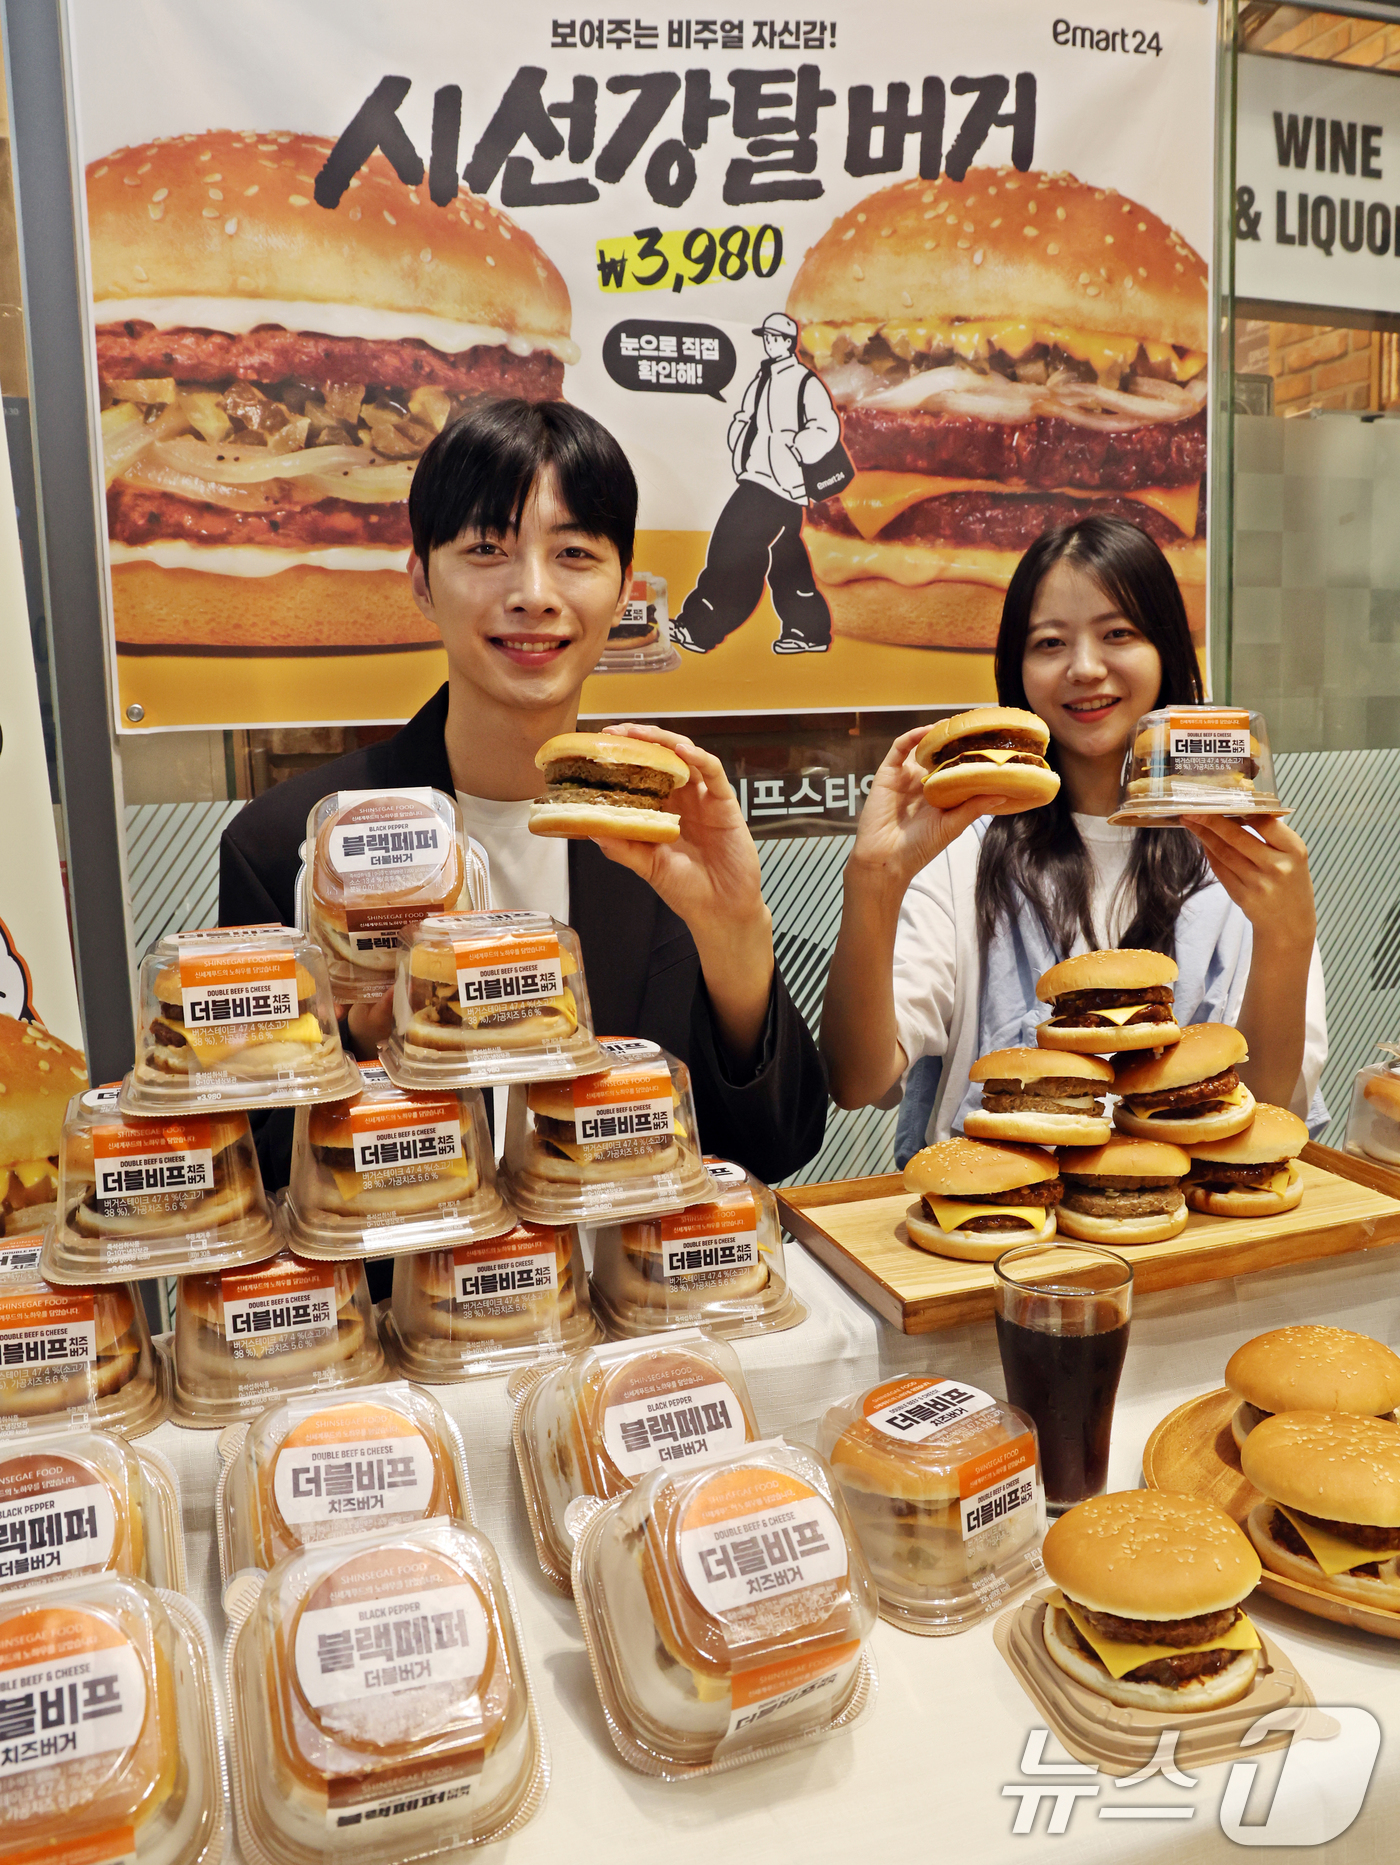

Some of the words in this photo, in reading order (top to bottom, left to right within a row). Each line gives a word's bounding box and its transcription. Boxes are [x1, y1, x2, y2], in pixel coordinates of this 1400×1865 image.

[551, 19, 659, 49] 보여주는
[668, 20, 744, 49] 비주얼
[752, 20, 837, 49] 자신감!
[1052, 19, 1162, 57] emart24
[314, 64, 837, 208] 시선강탈
[844, 72, 1037, 181] 버거
[1273, 111, 1383, 179] WINE
[1236, 185, 1261, 241] &
[1276, 190, 1400, 257] LIQUO
[597, 224, 783, 293] ₩3,980
[620, 332, 678, 357] 눈으로
[682, 337, 719, 360] 직접
[638, 360, 703, 384] 확인해!
[817, 472, 845, 490] emart24
[1175, 739, 1231, 753] 더블비프
[342, 829, 438, 857] 블랙페퍼
[370, 853, 413, 865] 더블버거
[480, 969, 500, 977] DOUBLE
[501, 967, 514, 975] BEEF
[520, 964, 538, 973] CHEESE
[540, 973, 556, 982] 치즈
[207, 988, 229, 996] DOUBLE
[231, 987, 244, 995] BEEF
[250, 985, 271, 993] CHEESE
[465, 974, 540, 1002] 더블비프
[541, 982, 557, 992] 버거
[273, 994, 290, 1004] 치즈
[190, 994, 272, 1022] 더블비프
[273, 1004, 291, 1014] 버거
[596, 1107, 615, 1116] DOUBLE
[616, 1106, 628, 1114] BEEF
[652, 1111, 668, 1120] 치즈
[162, 1126, 185, 1134] FOOD
[582, 1113, 652, 1138] 더블비프
[653, 1120, 668, 1130] 버거
[376, 1132, 397, 1141] DOUBLE
[398, 1131, 411, 1139] BEEF
[412, 1129, 416, 1137] &
[417, 1128, 436, 1136] CHEESE
[438, 1135, 454, 1145] 치즈
[361, 1137, 438, 1165] 더블비프
[438, 1145, 455, 1155] 버거
[120, 1159, 143, 1168] DOUBLE
[144, 1158, 158, 1166] BEEF
[164, 1155, 185, 1164] CHEESE
[187, 1164, 205, 1174] 치즈
[103, 1165, 186, 1193] 더블비프
[188, 1174, 206, 1184] 버거
[104, 1196, 149, 1208] 버거스테이크
[151, 1194, 169, 1204] 47.4
[104, 1208, 115, 1218] 38
[132, 1204, 163, 1215] 가공치즈
[165, 1203, 177, 1212] 5.6
[179, 1202, 187, 1210] %
[702, 1239, 714, 1247] BEEF
[477, 1264, 496, 1273] DOUBLE
[515, 1260, 534, 1268] CHEESE
[669, 1246, 736, 1271] 더블비프
[535, 1267, 550, 1275] 치즈
[462, 1269, 535, 1296] 더블비프
[536, 1277, 551, 1285] 버거
[45, 1298, 68, 1306] FOOD
[249, 1300, 269, 1309] DOUBLE
[290, 1295, 310, 1303] CHEESE
[312, 1302, 329, 1312] 치즈
[232, 1305, 312, 1334] 더블비프
[313, 1312, 330, 1322] 버거
[46, 1328, 68, 1336] CHEESE
[69, 1336, 88, 1346] 치즈
[70, 1347, 88, 1357] 버거
[630, 1372, 670, 1386] SHINSEGAE
[671, 1366, 692, 1376] FOOD
[647, 1401, 668, 1413] BLACK
[668, 1396, 692, 1407] PEPPER
[885, 1388, 976, 1430] 더블비프
[315, 1418, 361, 1428] SHINSEGAE
[363, 1415, 388, 1425] FOOD
[930, 1407, 968, 1426] 치즈버거
[620, 1400, 733, 1453] 블랙페퍼
[312, 1452, 340, 1461] DOUBLE
[341, 1449, 358, 1458] BEEF
[360, 1449, 365, 1457] &
[367, 1445, 393, 1455] CHEESE
[658, 1439, 708, 1462] 더블버거
[1004, 1449, 1019, 1461] FOOD
[37, 1466, 63, 1477] FOOD
[292, 1456, 417, 1498] 더블비프
[978, 1492, 992, 1504] DOUBLE
[993, 1487, 1002, 1496] BEEF
[1006, 1478, 1019, 1490] CHEESE
[1021, 1482, 1032, 1494] 치즈
[328, 1494, 384, 1514] 치즈버거
[1021, 1491, 1032, 1505] 버거
[25, 1500, 55, 1514] PEPPER
[967, 1488, 1020, 1532] 더블비프
[714, 1527, 742, 1541] DOUBLE
[742, 1522, 760, 1534] BEEF
[762, 1520, 768, 1528] &
[768, 1512, 796, 1526] CHEESE
[698, 1520, 830, 1584] 더블비프
[0, 1551, 61, 1577] 더블버거
[340, 1569, 395, 1585] SHINSEGAE
[397, 1562, 427, 1574] FOOD
[746, 1565, 804, 1596] 치즈버거
[358, 1607, 387, 1621] BLACK
[388, 1602, 421, 1617] PEPPER
[317, 1609, 470, 1674] 블랙페퍼
[21, 1673, 43, 1687] BEEF
[46, 1672, 52, 1681] &
[55, 1663, 90, 1679] CHEESE
[364, 1660, 432, 1689] 더블버거
[734, 1681, 817, 1731] 더블비프
[1, 1731, 76, 1766] 치즈버거
[337, 1790, 446, 1828] 블랙페퍼
